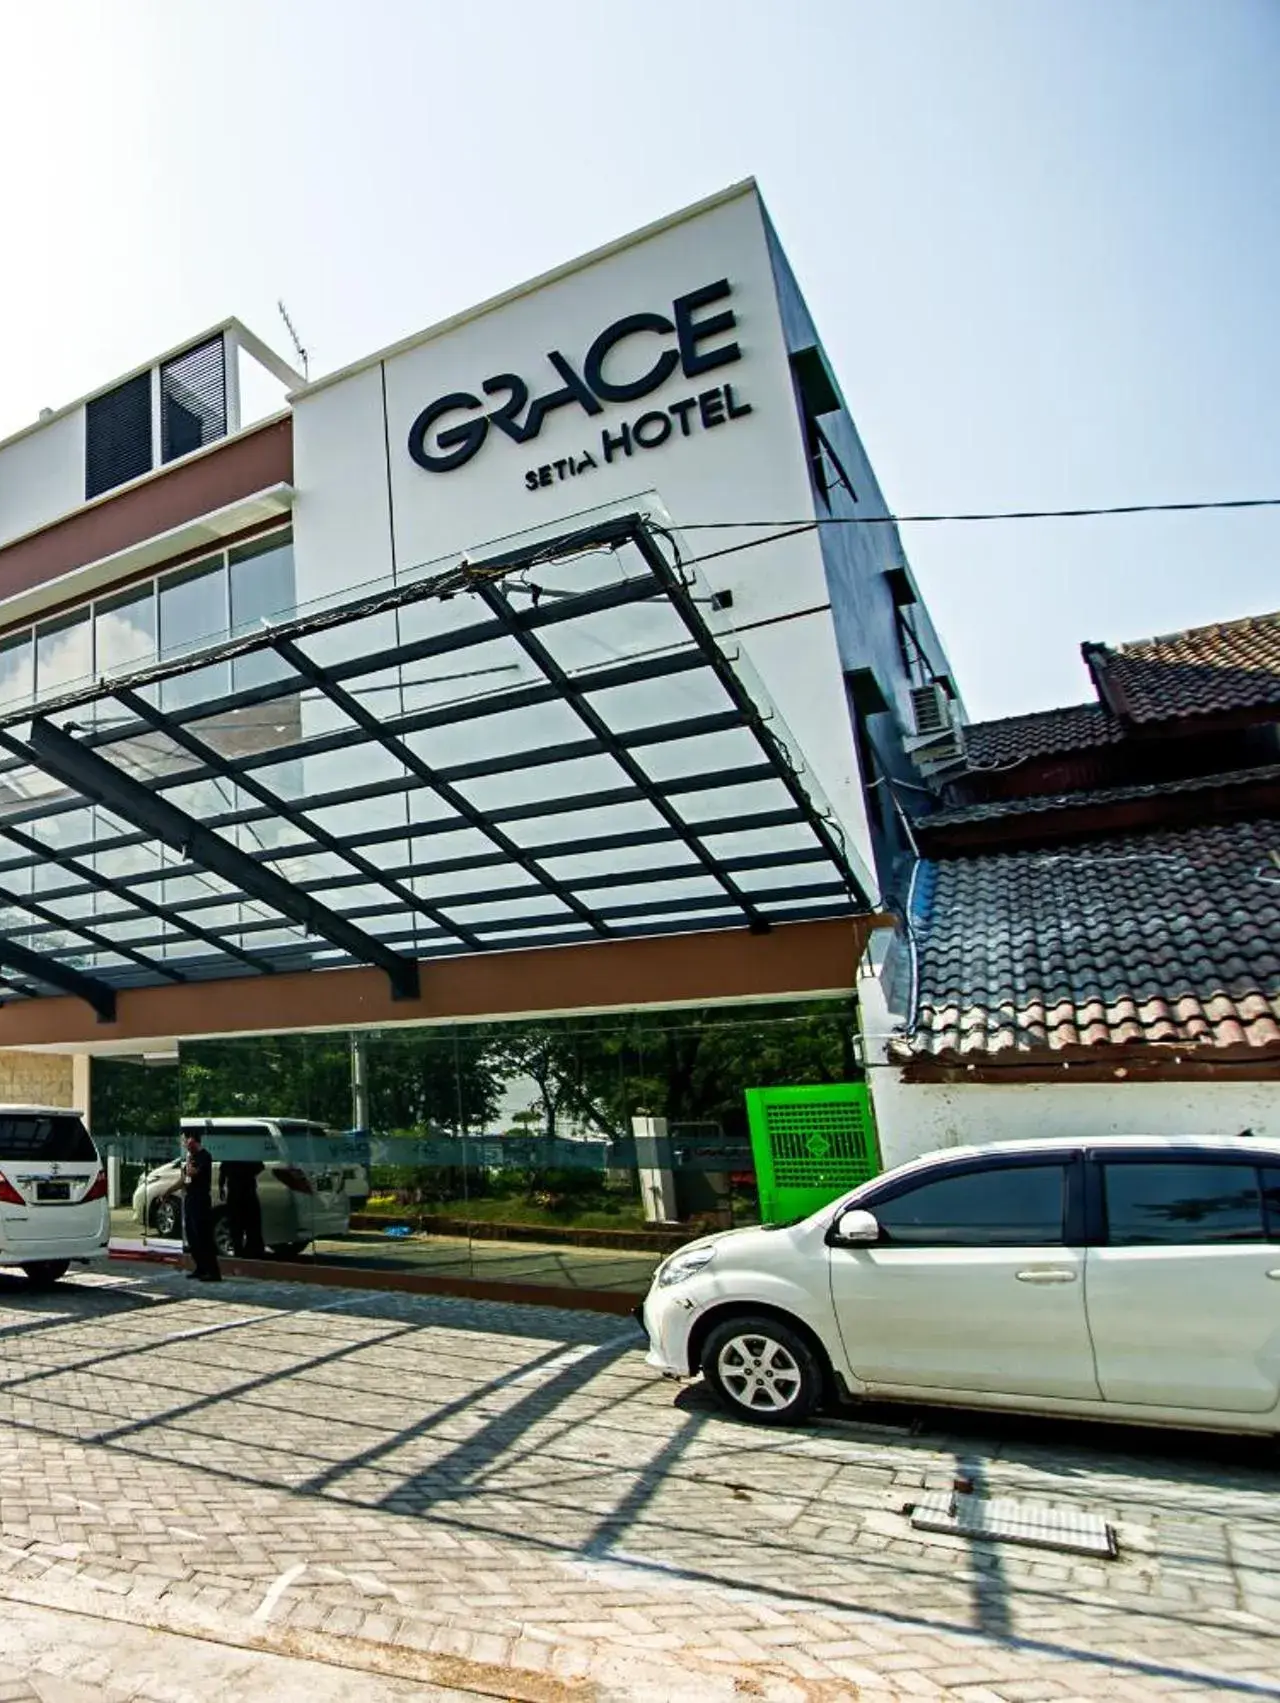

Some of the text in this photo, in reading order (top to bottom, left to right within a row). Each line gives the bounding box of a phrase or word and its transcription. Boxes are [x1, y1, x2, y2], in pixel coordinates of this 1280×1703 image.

[408, 278, 742, 473] GRACE
[525, 384, 753, 492] SETIA HOTEL
